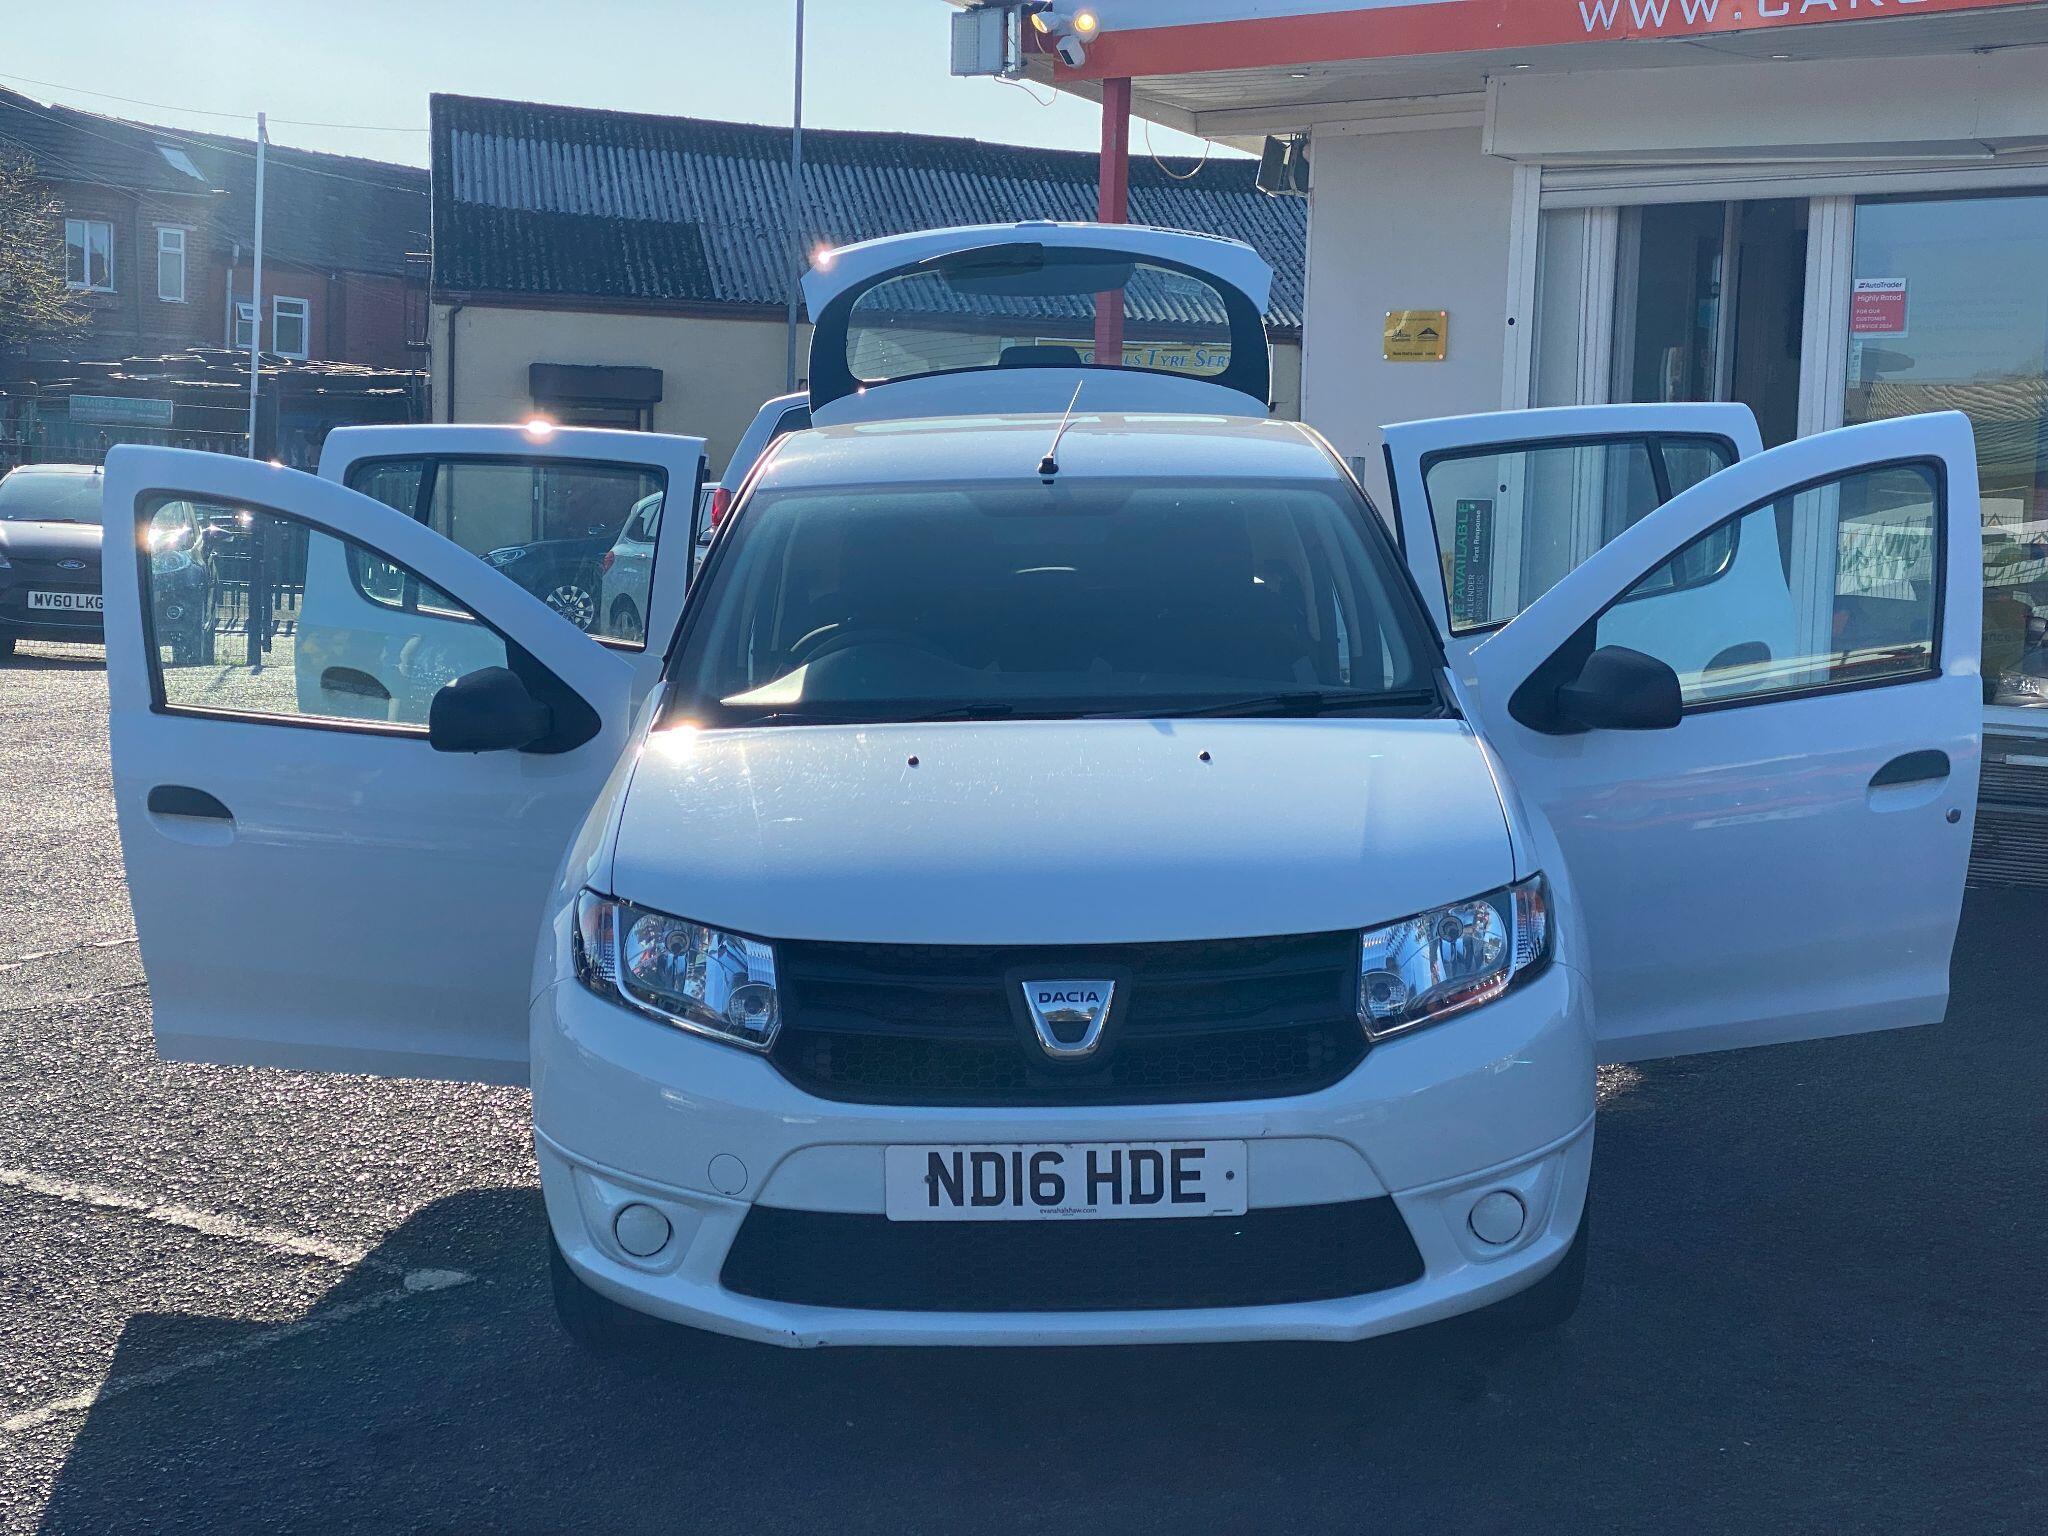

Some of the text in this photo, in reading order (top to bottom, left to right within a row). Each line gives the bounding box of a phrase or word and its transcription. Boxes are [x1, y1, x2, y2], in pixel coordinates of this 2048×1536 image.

[1864, 281, 1903, 289] AutoTrader
[1857, 293, 1902, 303] Highly Rated
[1147, 349, 1190, 367] TYRE
[1193, 349, 1231, 368] SER
[1473, 509, 1483, 545] Response
[1455, 503, 1469, 598] AVAILABLE
[1467, 574, 1475, 607] LENDER
[34, 593, 103, 609] MV60 LKG
[1038, 991, 1100, 1003] DACIA
[928, 1147, 1206, 1207] ND16 HDE
[1039, 1206, 1097, 1214] evanshalshaw.com
